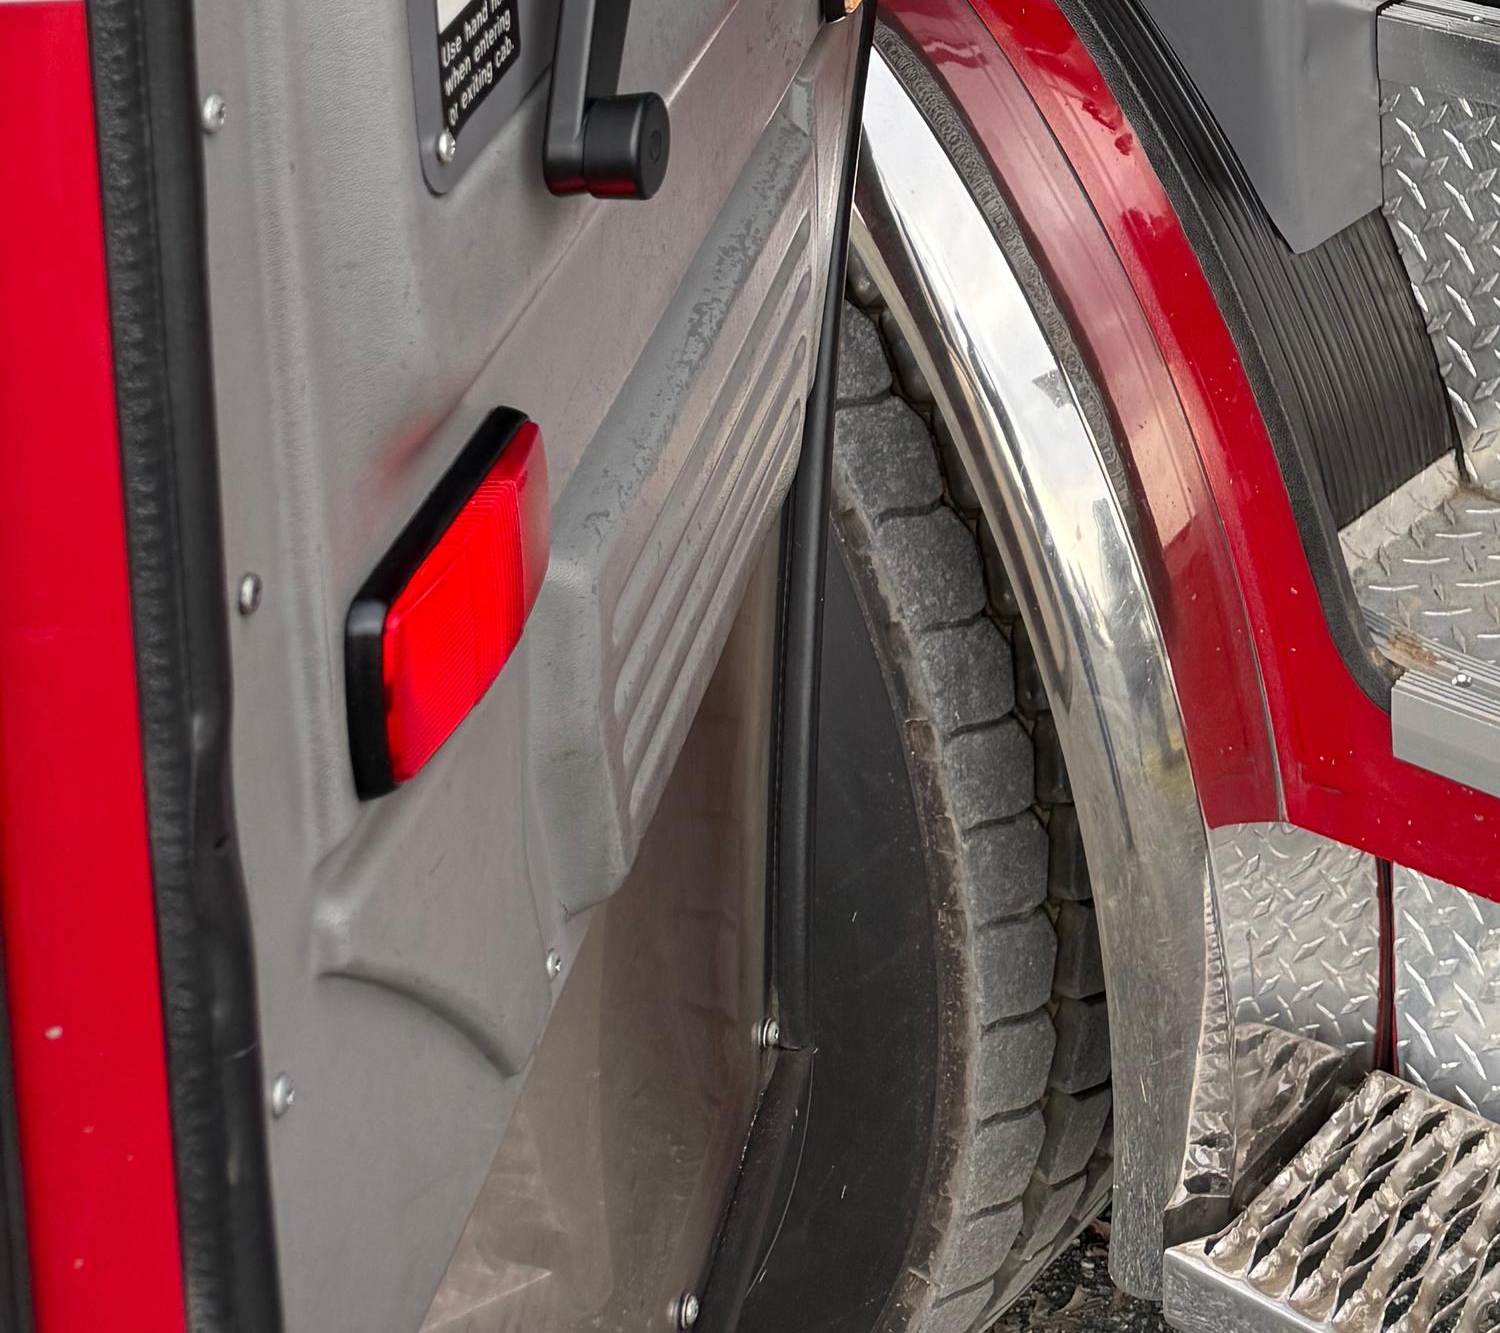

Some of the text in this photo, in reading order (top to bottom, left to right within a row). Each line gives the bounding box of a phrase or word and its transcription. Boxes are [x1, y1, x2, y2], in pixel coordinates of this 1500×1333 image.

[441, 35, 462, 69] Use
[464, 0, 488, 42] hand
[445, 9, 511, 96] when entering
[449, 36, 515, 126] or exiting cab.
